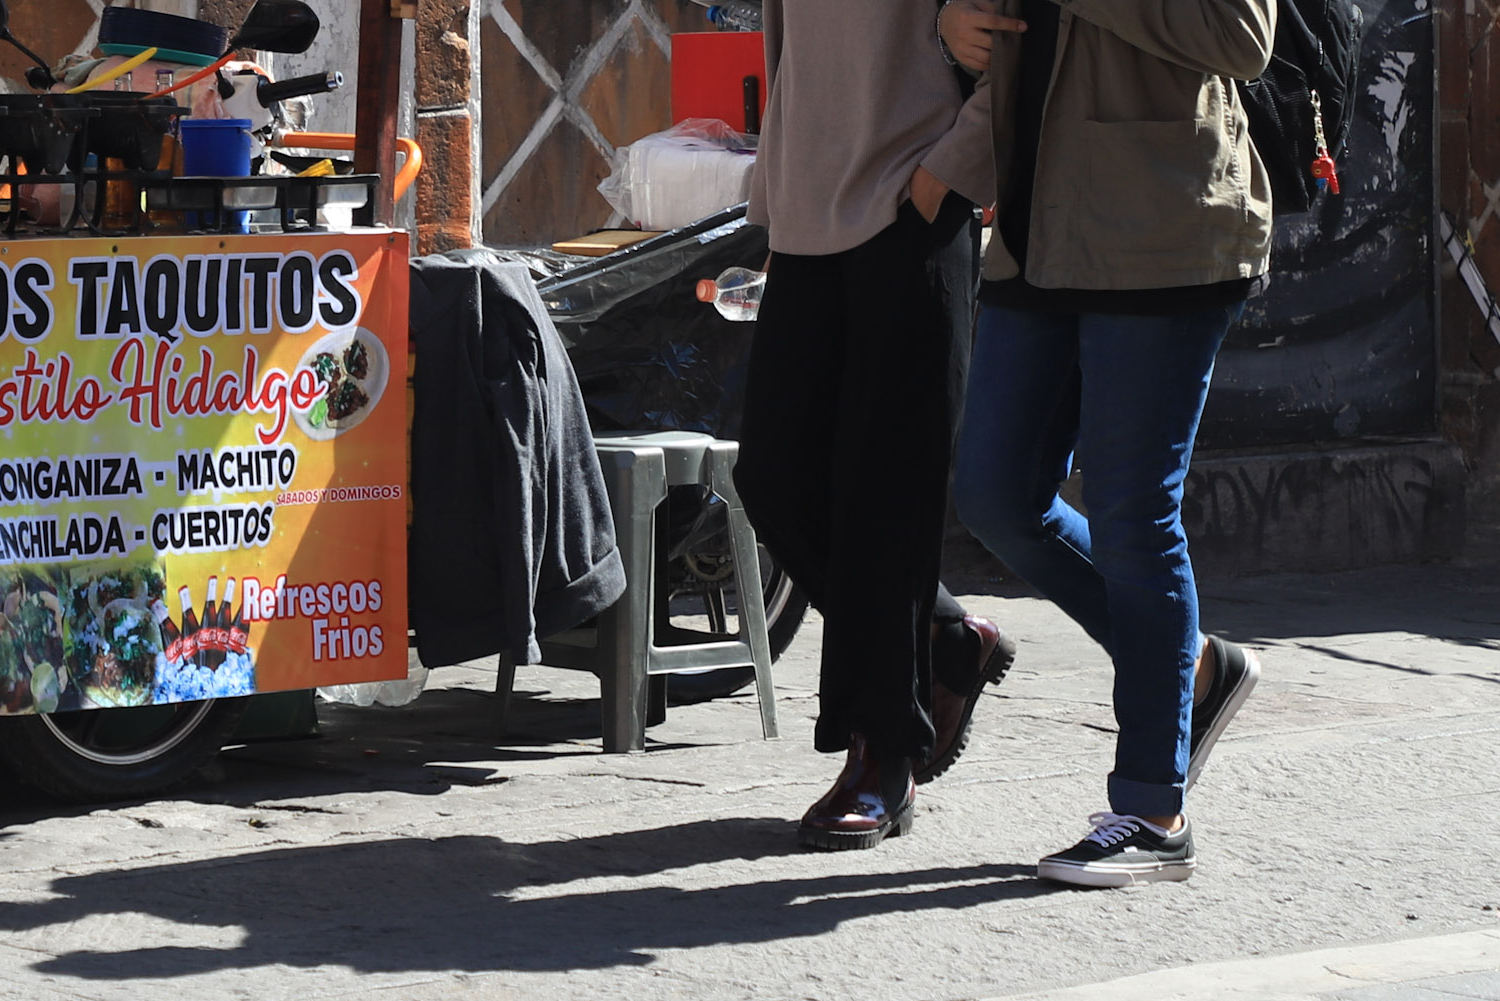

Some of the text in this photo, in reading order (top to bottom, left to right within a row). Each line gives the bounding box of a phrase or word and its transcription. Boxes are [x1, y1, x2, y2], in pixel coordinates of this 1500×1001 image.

[71, 254, 358, 343] TAQUITOS
[110, 339, 329, 444] Hidalgo
[178, 449, 295, 491] MACHITO
[276, 486, 401, 506] SABADOS Y DOMINGOS
[152, 507, 273, 551] CUERITOS
[242, 578, 383, 621] Refrescos
[313, 620, 385, 662] Frios
